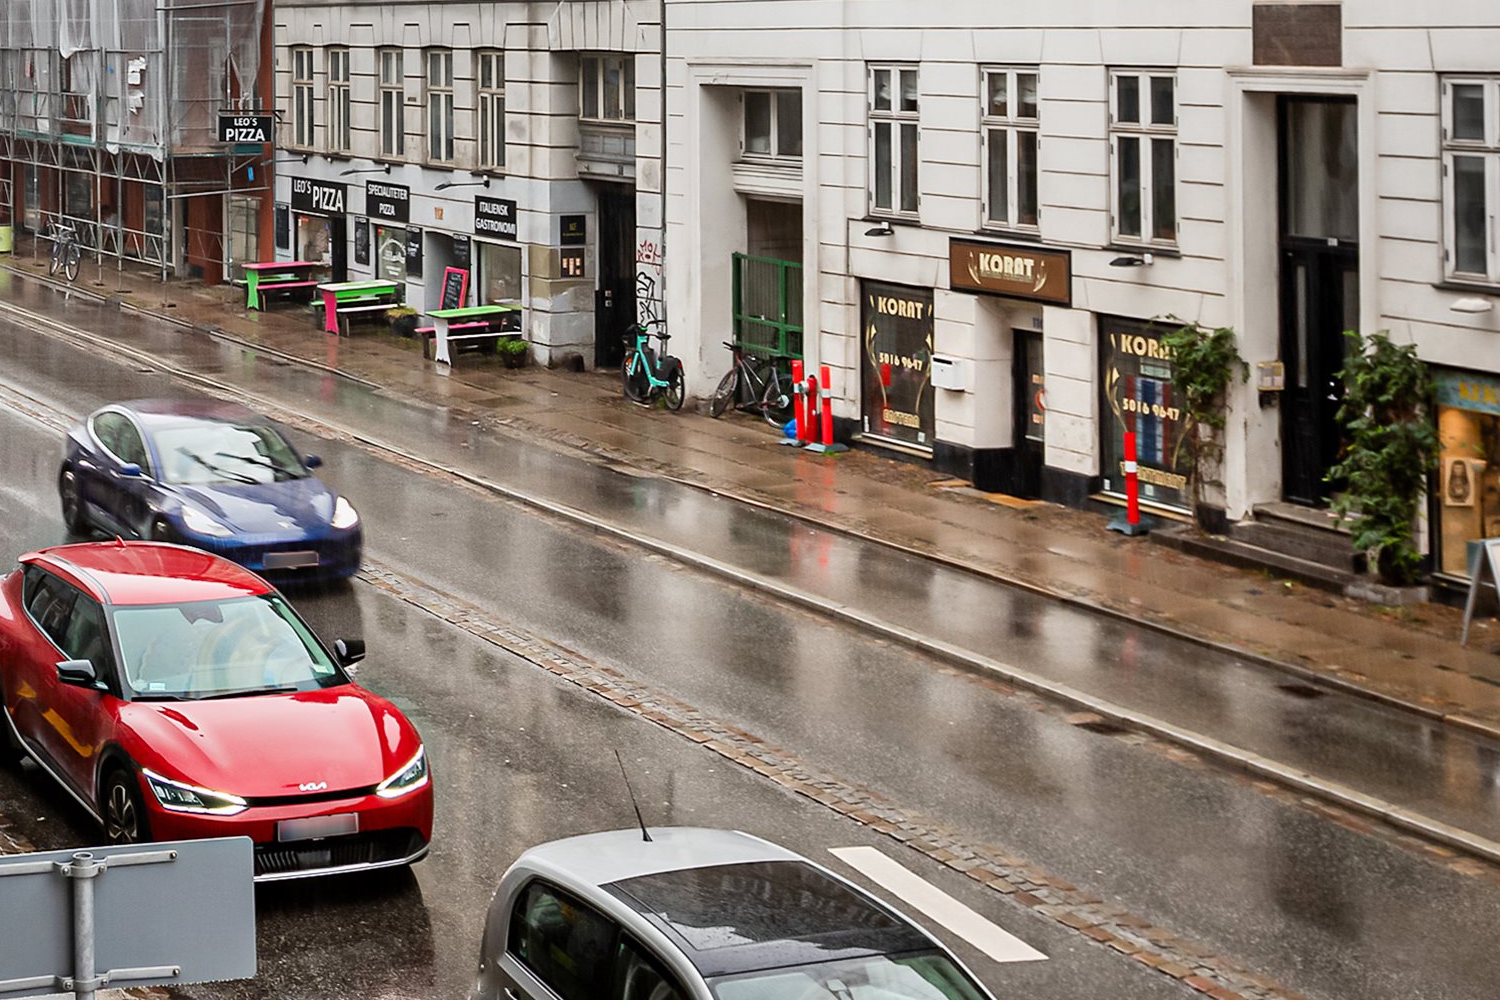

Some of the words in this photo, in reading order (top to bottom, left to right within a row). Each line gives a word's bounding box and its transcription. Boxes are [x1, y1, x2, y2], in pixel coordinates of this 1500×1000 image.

[225, 128, 266, 142] PIZZA
[312, 185, 344, 213] PIZZA
[367, 183, 408, 200] SPECIALITETER
[379, 202, 396, 216] PIZZA
[479, 201, 509, 216] ITALIENSK
[475, 217, 516, 235] GASTRONOMI
[979, 252, 1035, 277] KORAT
[878, 296, 924, 319] KORAT
[1120, 333, 1178, 360] KOR
[879, 352, 900, 366] 5016
[1122, 397, 1150, 415] 5016
[1152, 403, 1180, 422] 9647
